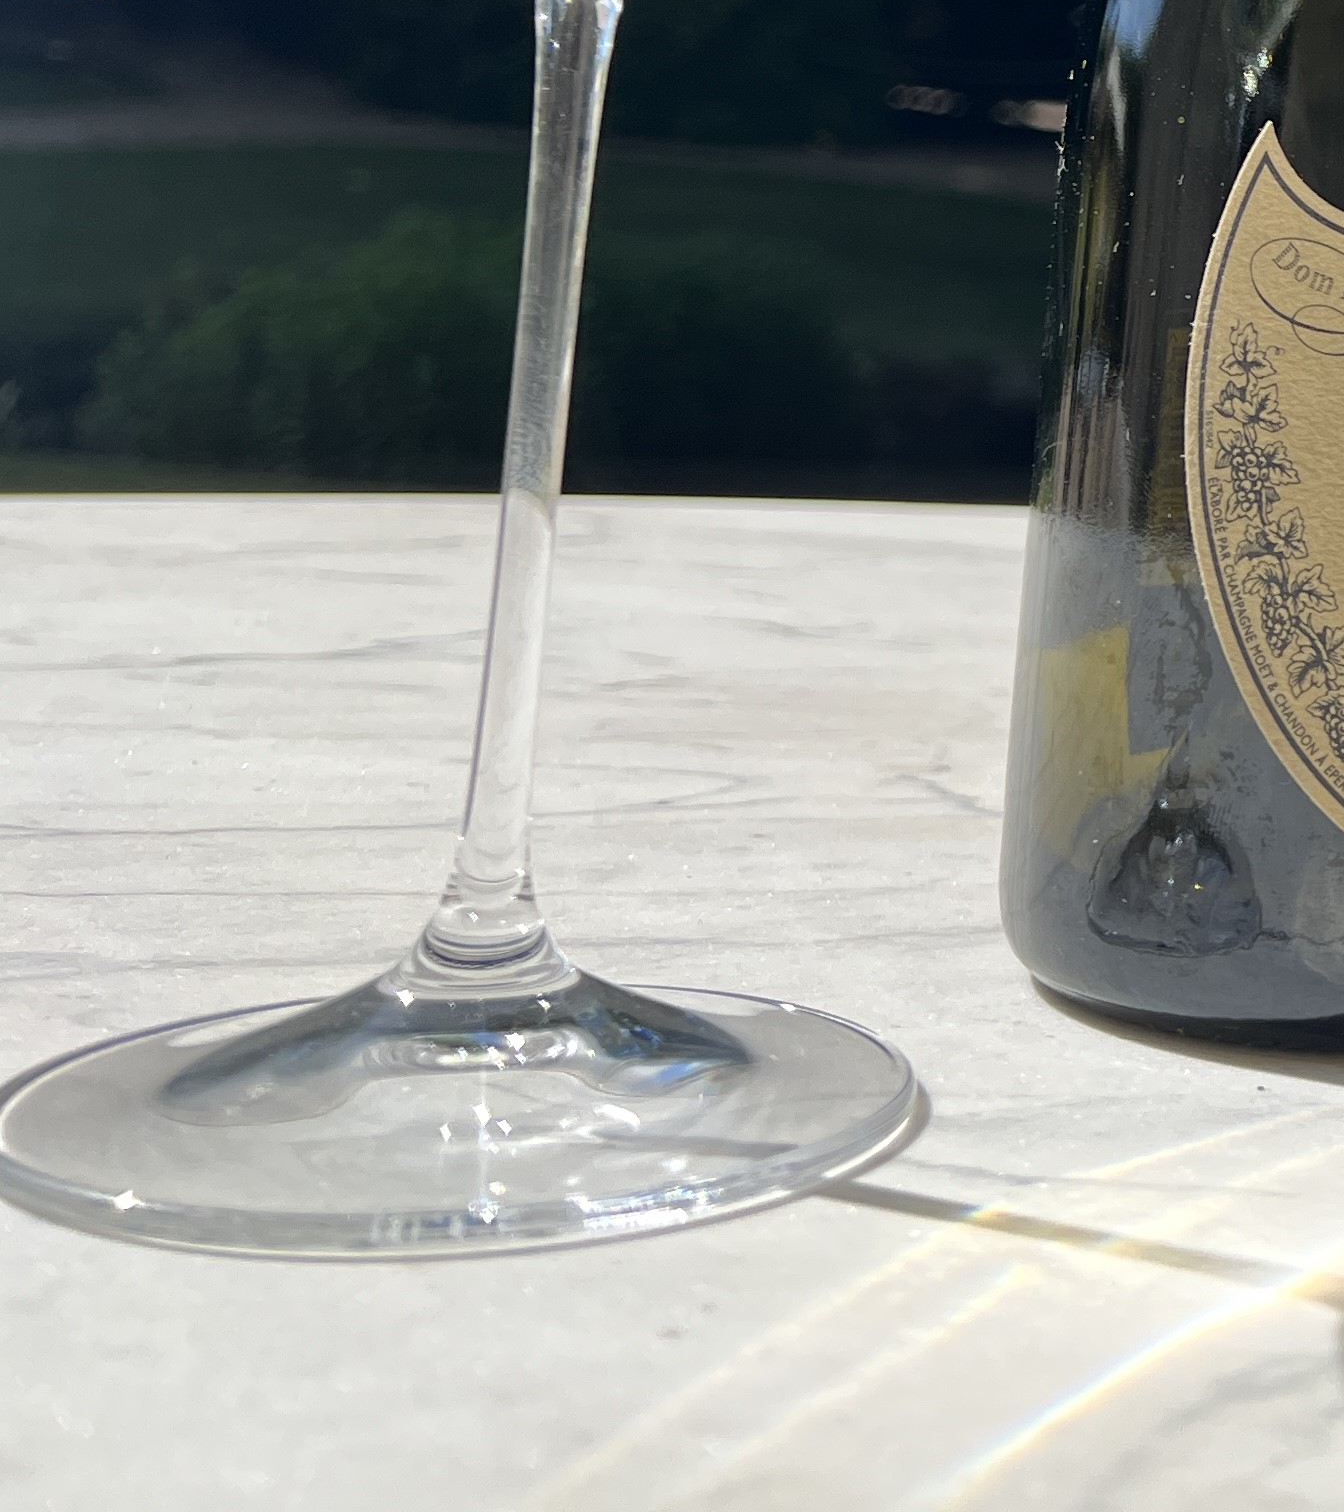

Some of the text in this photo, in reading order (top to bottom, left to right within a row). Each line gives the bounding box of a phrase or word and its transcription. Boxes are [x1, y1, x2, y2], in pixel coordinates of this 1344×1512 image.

[1272, 242, 1335, 296] Dom
[1216, 537, 1231, 562] PAR
[1223, 563, 1258, 644] CHAMPAGNE
[1267, 681, 1280, 693] &
[1273, 693, 1320, 757] CHANDON
